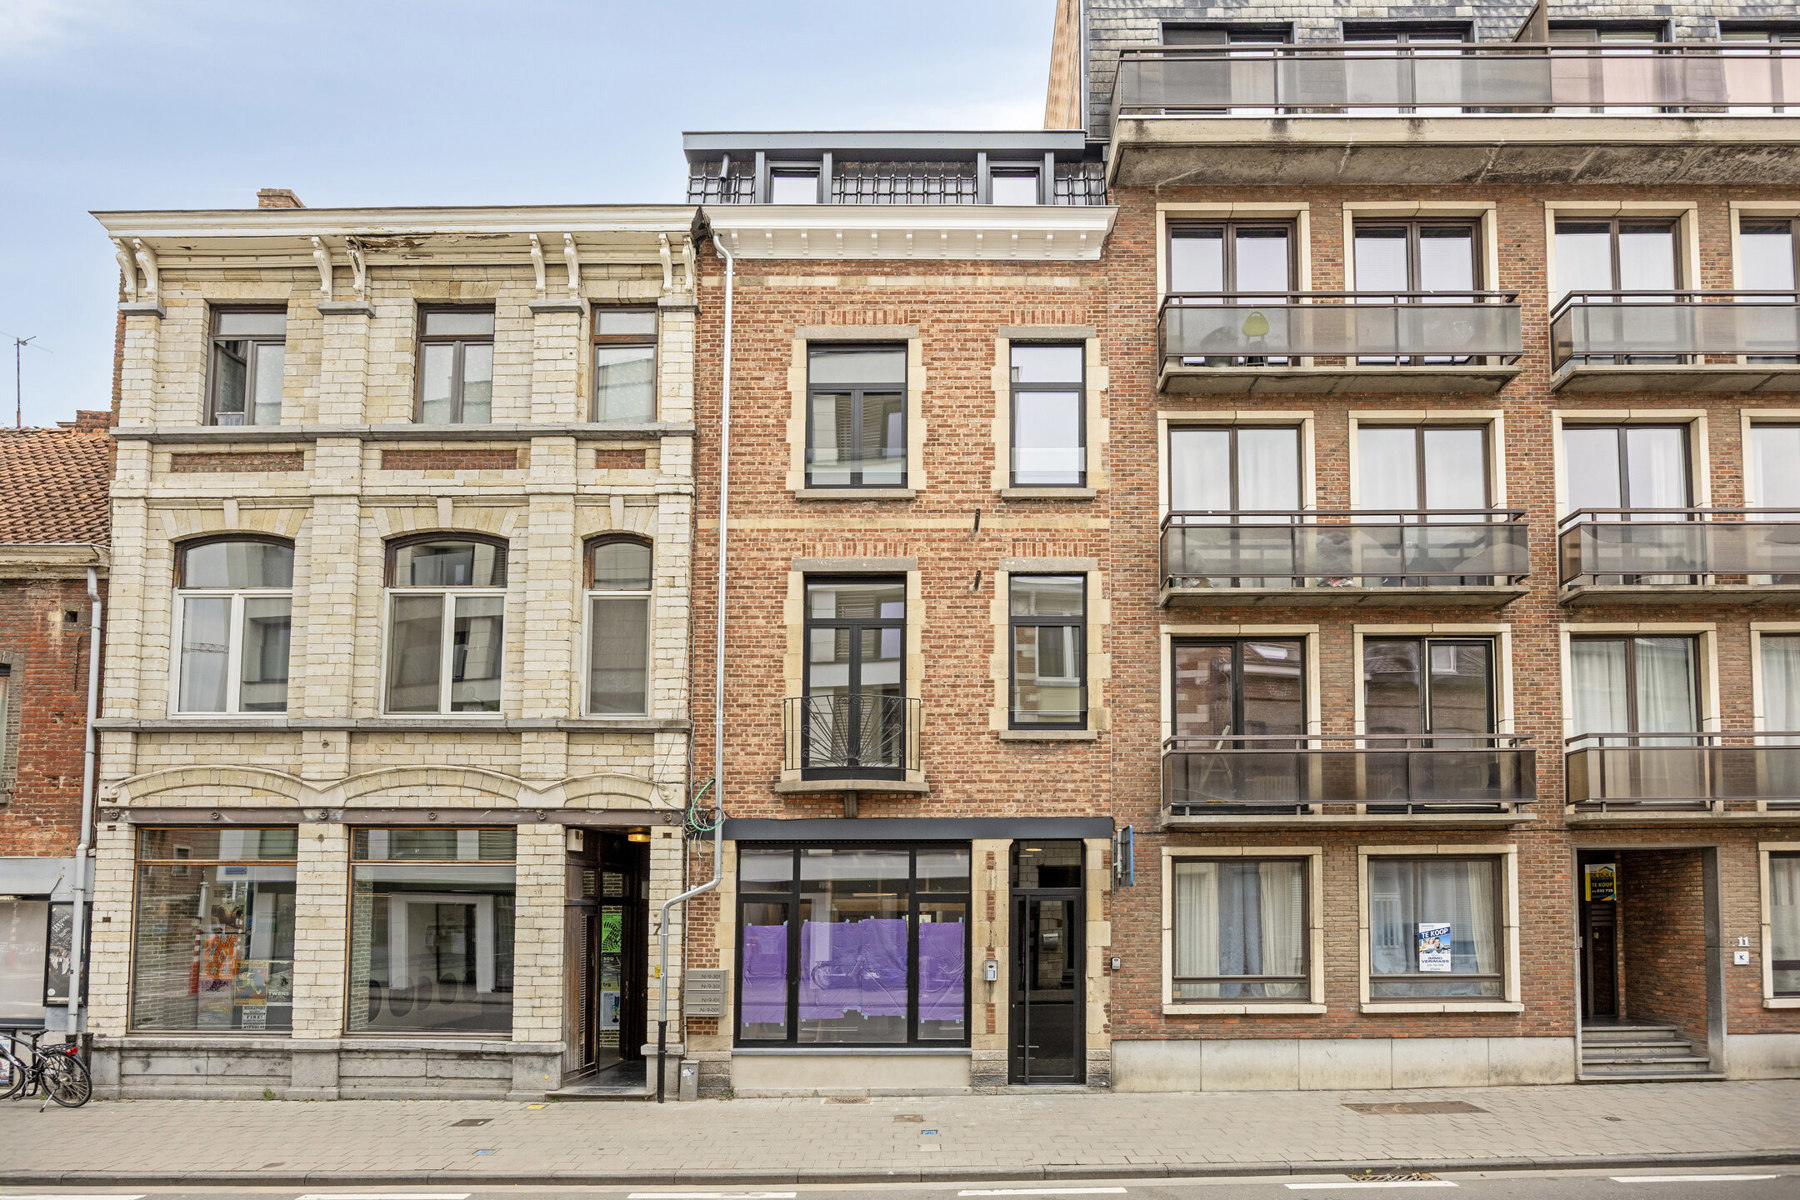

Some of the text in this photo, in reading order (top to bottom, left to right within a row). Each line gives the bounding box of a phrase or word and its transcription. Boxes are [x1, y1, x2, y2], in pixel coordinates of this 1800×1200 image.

[653, 923, 661, 935] 7
[1421, 931, 1429, 939] TE
[1430, 927, 1449, 937] KOOP
[1737, 936, 1750, 947] 11
